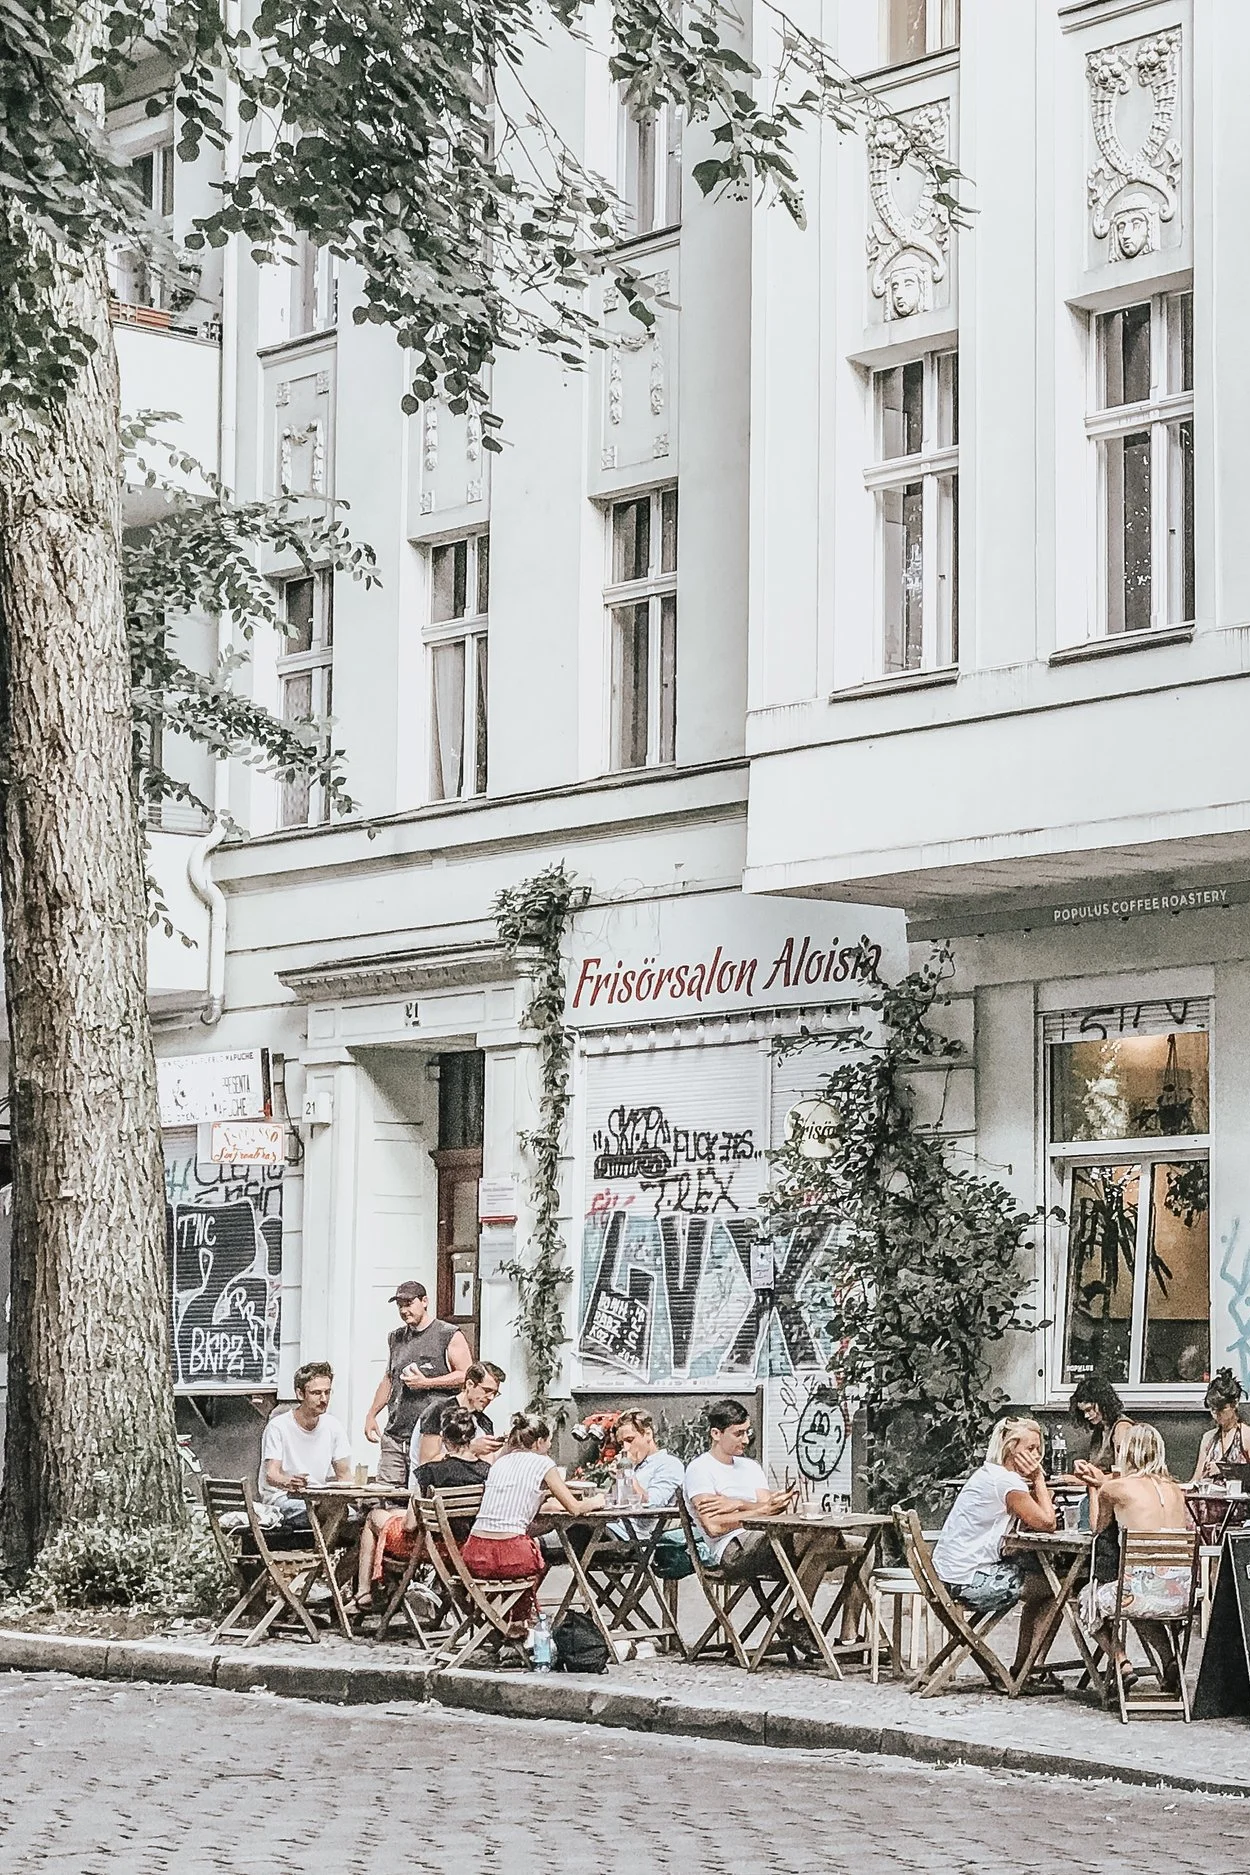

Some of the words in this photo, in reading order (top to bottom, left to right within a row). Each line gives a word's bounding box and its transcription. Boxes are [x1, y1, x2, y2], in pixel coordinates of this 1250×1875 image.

[1053, 903, 1110, 922] POPULUS
[1111, 897, 1159, 914] COFFEE
[1160, 889, 1227, 909] ROASTERY
[572, 945, 758, 1008] Frisörsalon
[305, 1101, 316, 1115] 21
